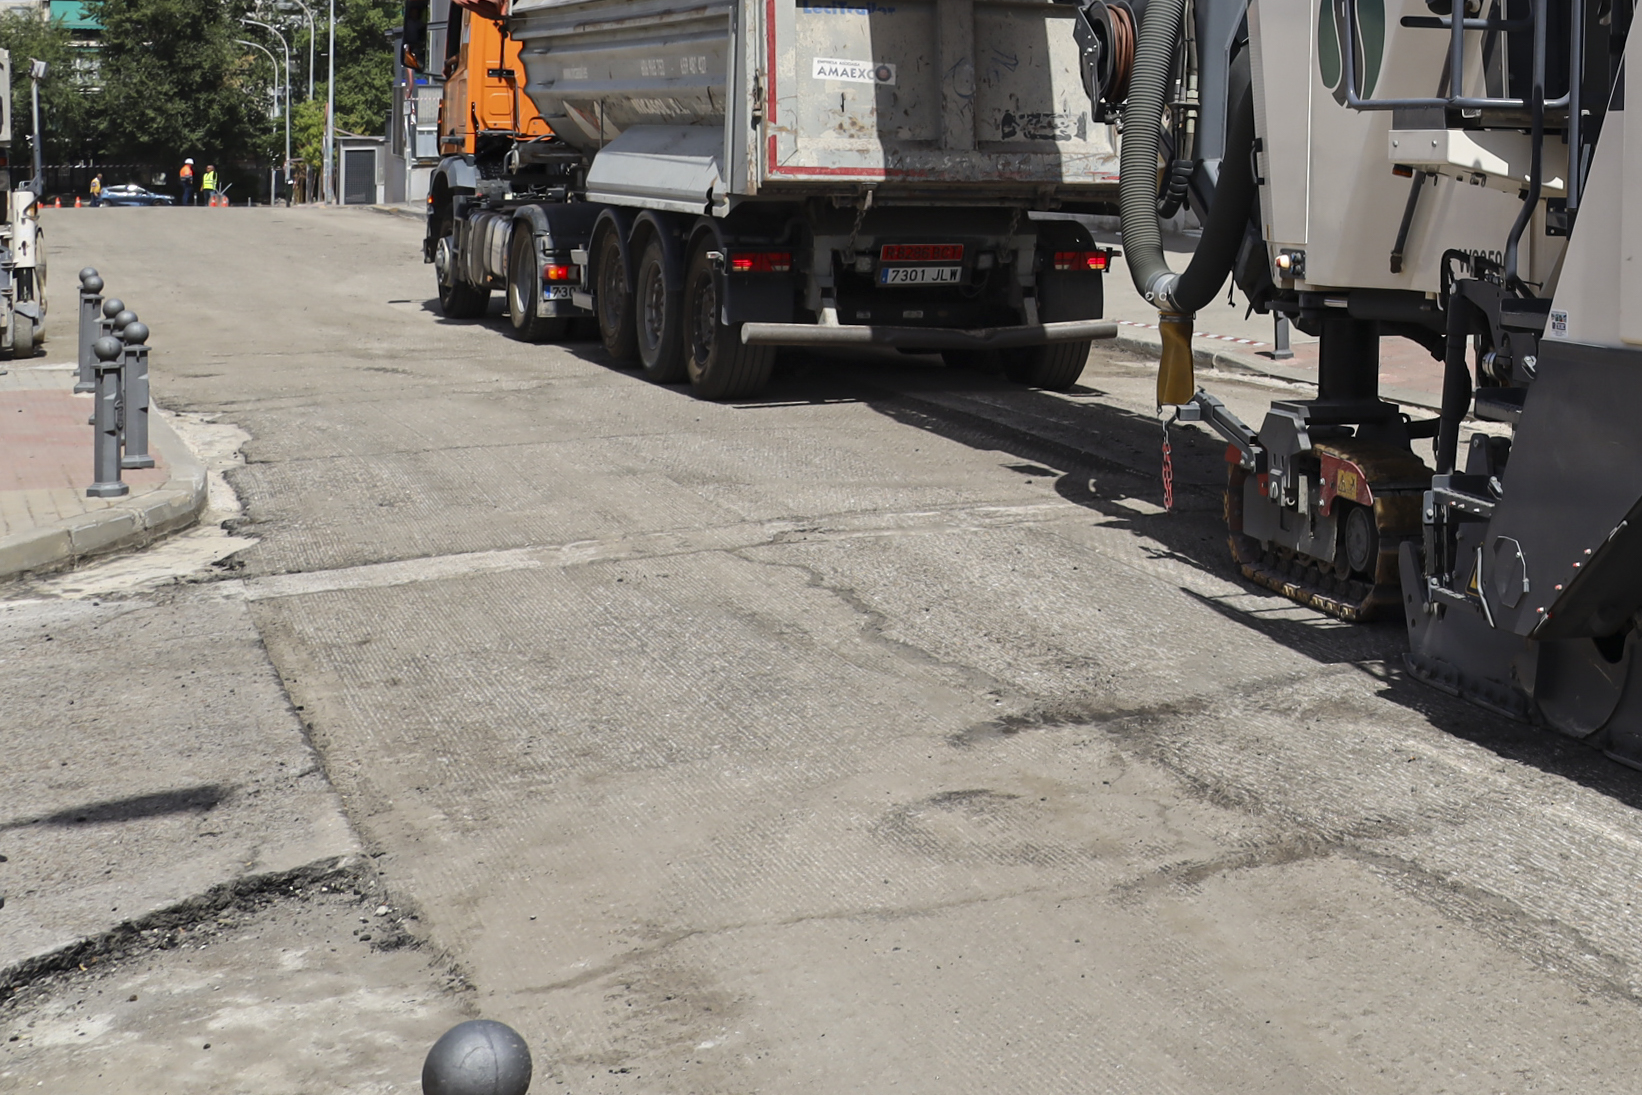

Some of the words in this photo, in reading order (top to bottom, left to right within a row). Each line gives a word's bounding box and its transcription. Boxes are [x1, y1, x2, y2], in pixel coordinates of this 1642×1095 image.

[891, 269, 926, 282] 7301
[931, 268, 959, 282] JLW
[552, 285, 584, 299] 730
